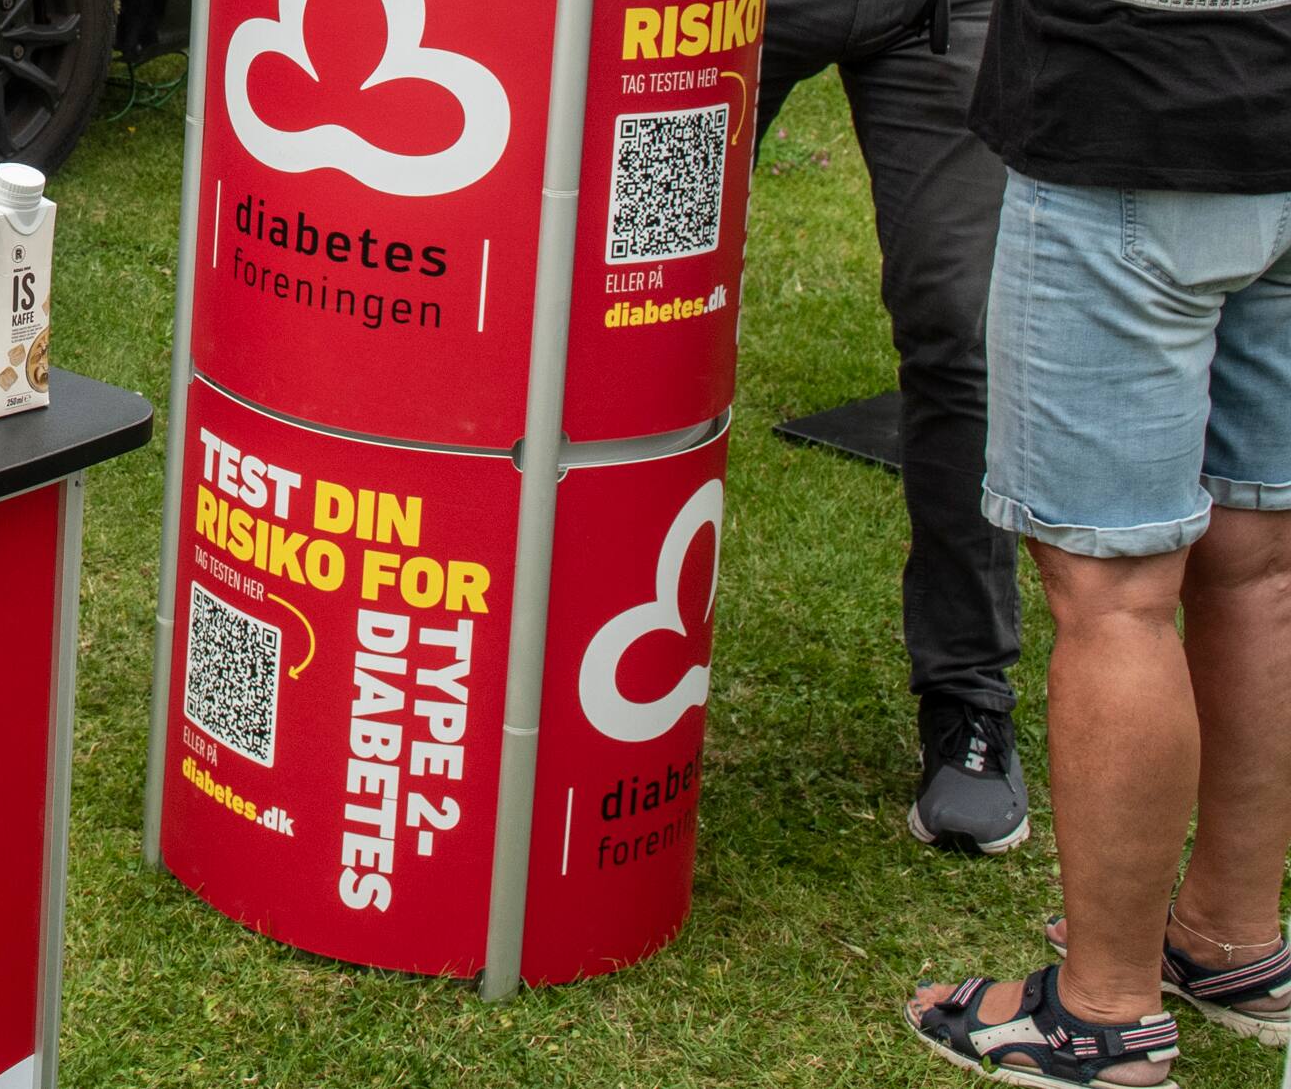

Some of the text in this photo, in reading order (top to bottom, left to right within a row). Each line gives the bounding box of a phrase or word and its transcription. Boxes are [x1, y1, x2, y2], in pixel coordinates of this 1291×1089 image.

[621, 67, 718, 95] TAG TESTEN HER
[235, 195, 448, 278] diabetes
[12, 272, 36, 313] IS
[232, 247, 443, 330] foreningen
[605, 267, 664, 293] ELLER PÅ
[605, 285, 727, 328] diabetes.dk
[11, 311, 35, 328] KAFFE
[200, 426, 422, 548] TEST DIN
[194, 545, 265, 602] TAG TESTEN HER
[195, 484, 491, 615] RISIKO FOR
[183, 725, 218, 767] ELLER PÅ
[338, 609, 411, 913] DIABETES
[406, 619, 474, 857] TYPE 2-
[181, 756, 295, 837] diabetes.dk
